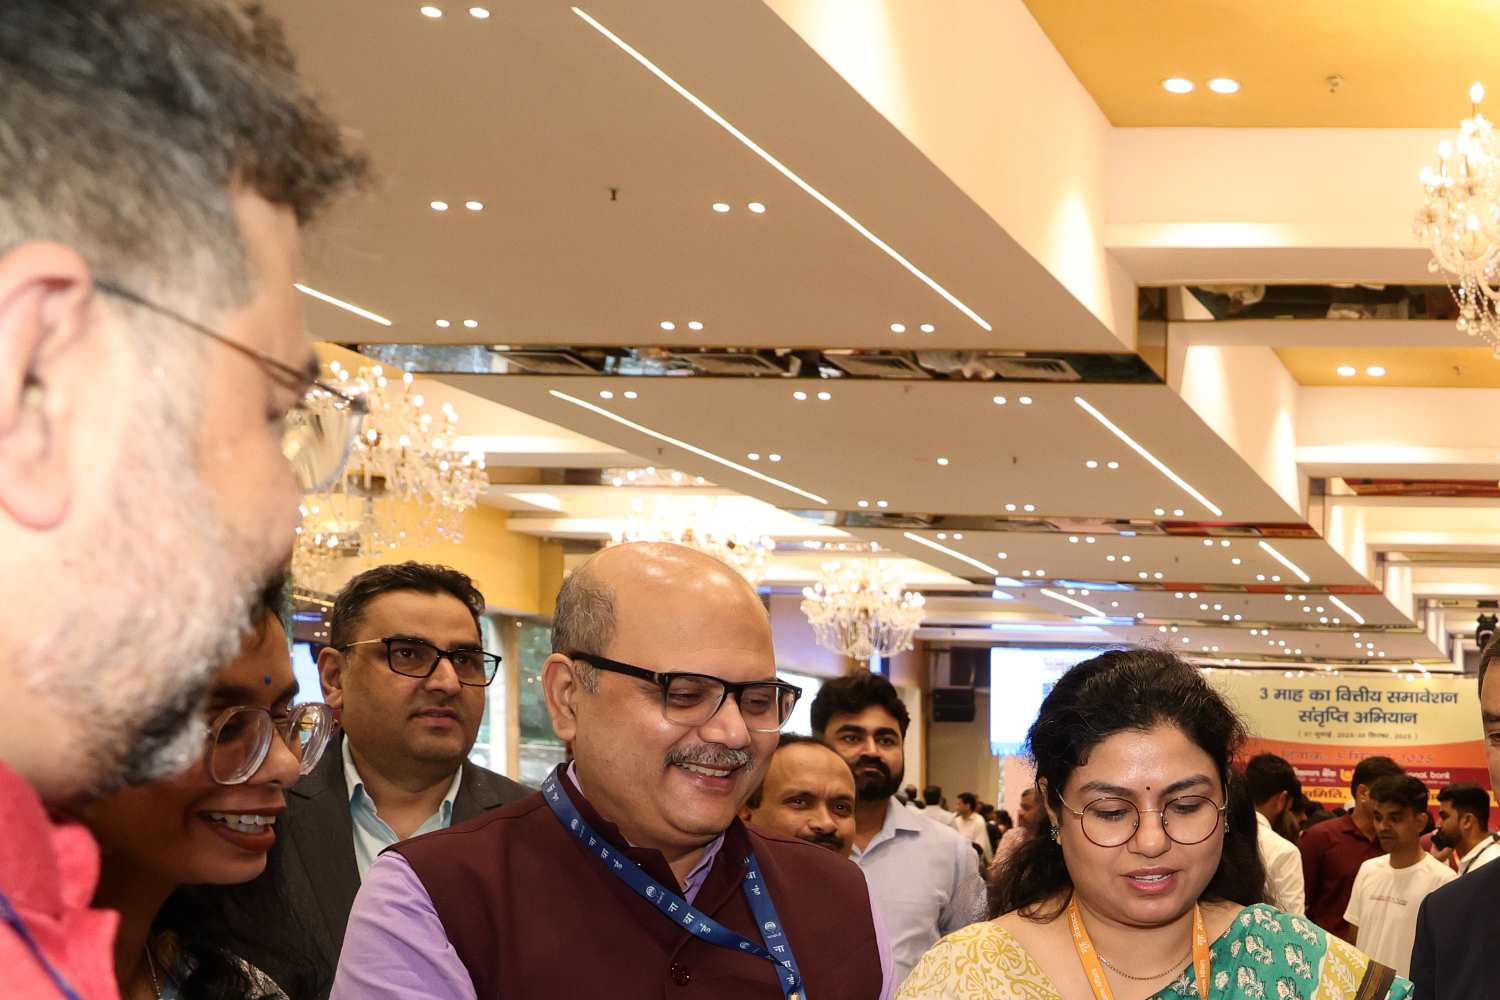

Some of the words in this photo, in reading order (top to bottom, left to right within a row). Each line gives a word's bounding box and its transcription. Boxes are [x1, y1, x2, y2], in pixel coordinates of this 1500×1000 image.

[1259, 688, 1268, 699] 3
[1273, 688, 1302, 700] माह
[1309, 688, 1330, 700] का
[1336, 685, 1380, 703] वित्तीय
[1387, 687, 1458, 704] समावेशन
[1299, 706, 1348, 727] संतृप्ति
[1353, 706, 1417, 724] अभियान
